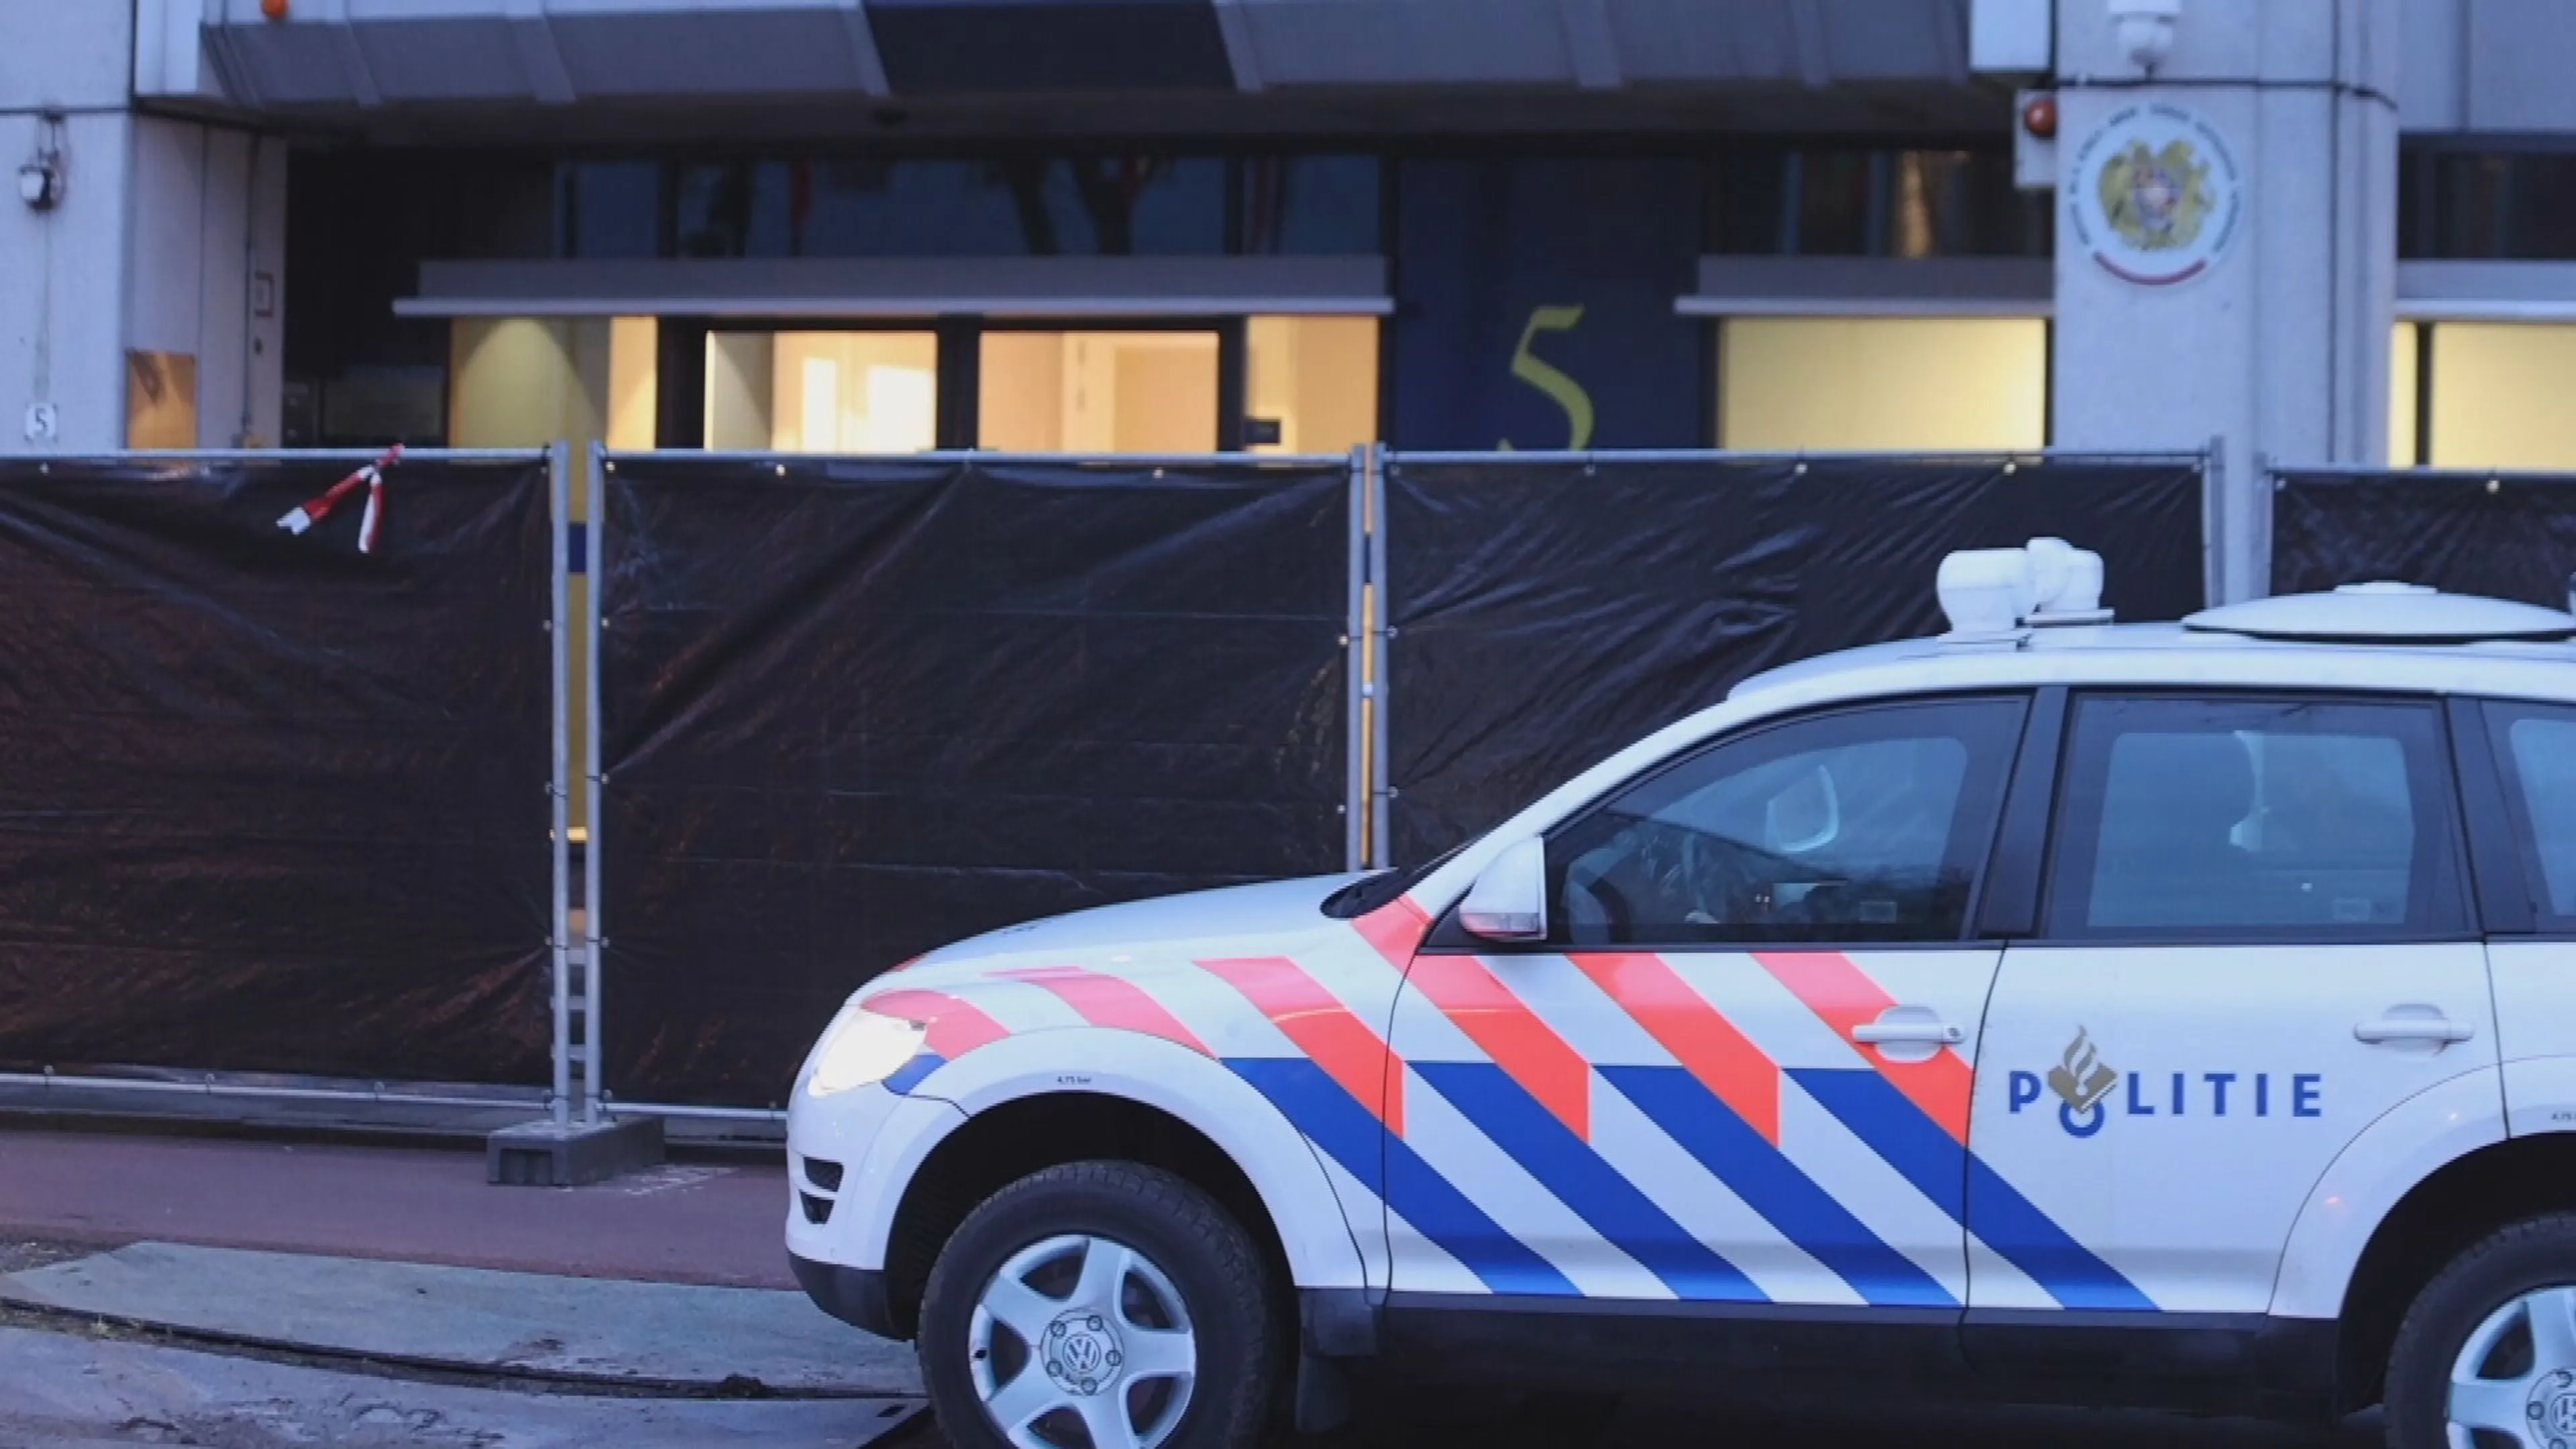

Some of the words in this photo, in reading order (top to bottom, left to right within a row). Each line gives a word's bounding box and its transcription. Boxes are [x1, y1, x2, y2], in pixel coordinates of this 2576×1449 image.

[1495, 305, 1594, 451] 5
[35, 407, 49, 437] 5
[2008, 1071, 2322, 1138] POLITIE
